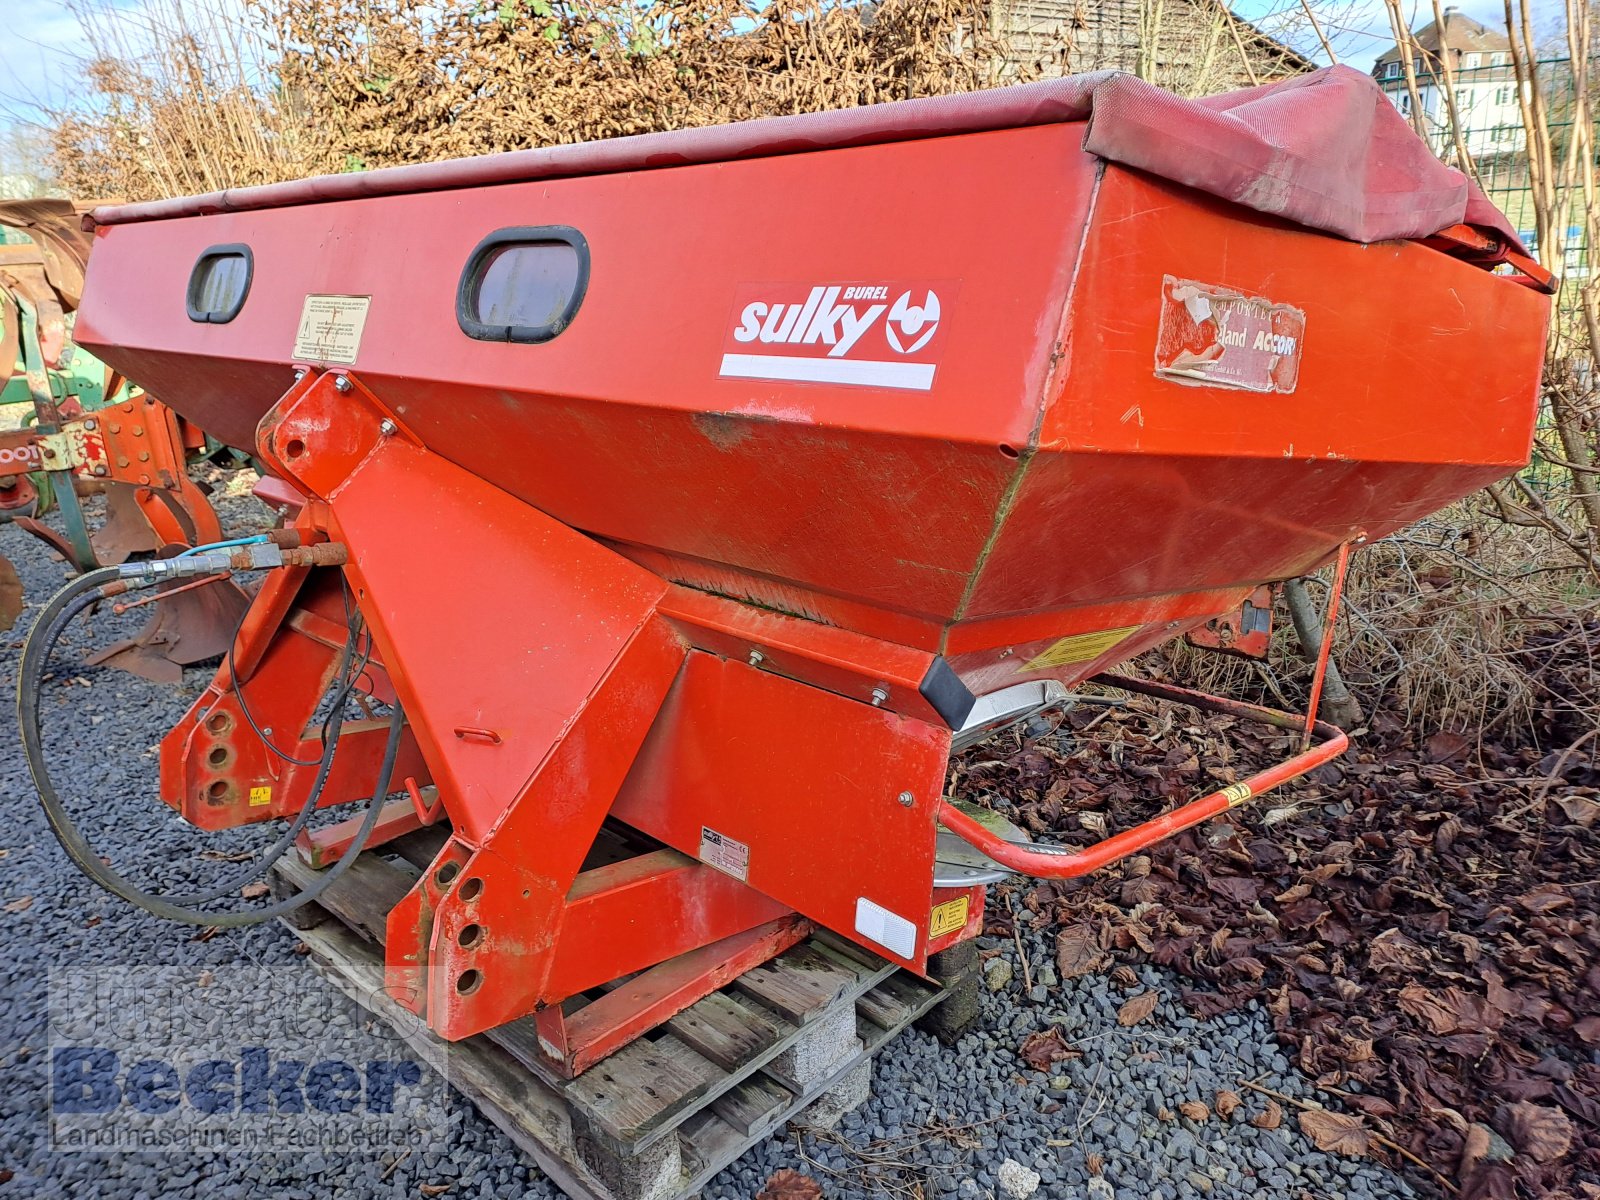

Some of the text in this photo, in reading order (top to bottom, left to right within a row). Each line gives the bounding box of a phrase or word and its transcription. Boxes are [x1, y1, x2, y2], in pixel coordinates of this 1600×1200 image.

[843, 286, 888, 300] BUREL
[734, 286, 888, 357] sulky
[1217, 324, 1248, 348] eland
